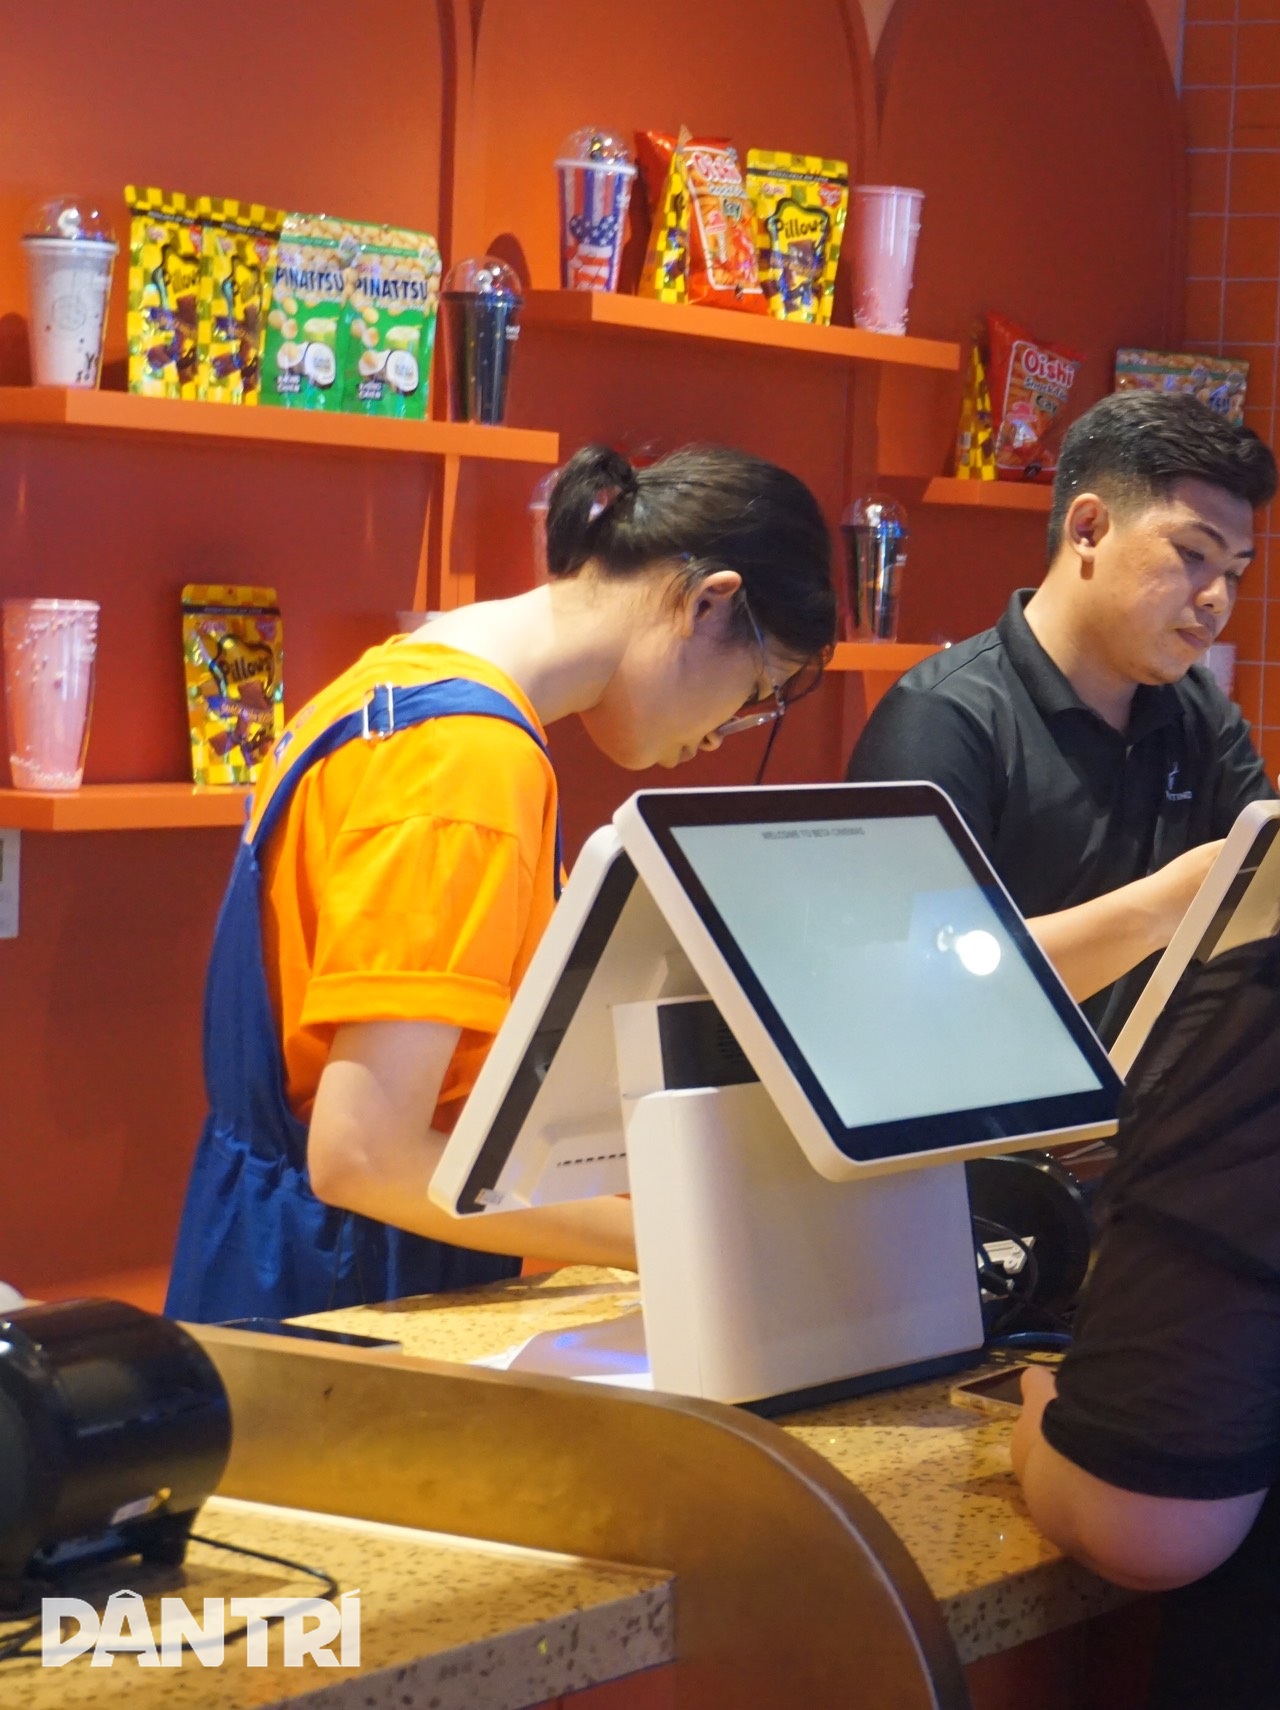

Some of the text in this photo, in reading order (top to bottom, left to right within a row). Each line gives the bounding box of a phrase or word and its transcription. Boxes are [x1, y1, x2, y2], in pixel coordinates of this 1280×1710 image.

[275, 266, 344, 291] PINATTSU
[356, 276, 428, 299] PINATTSU
[1022, 348, 1075, 389] Oishi
